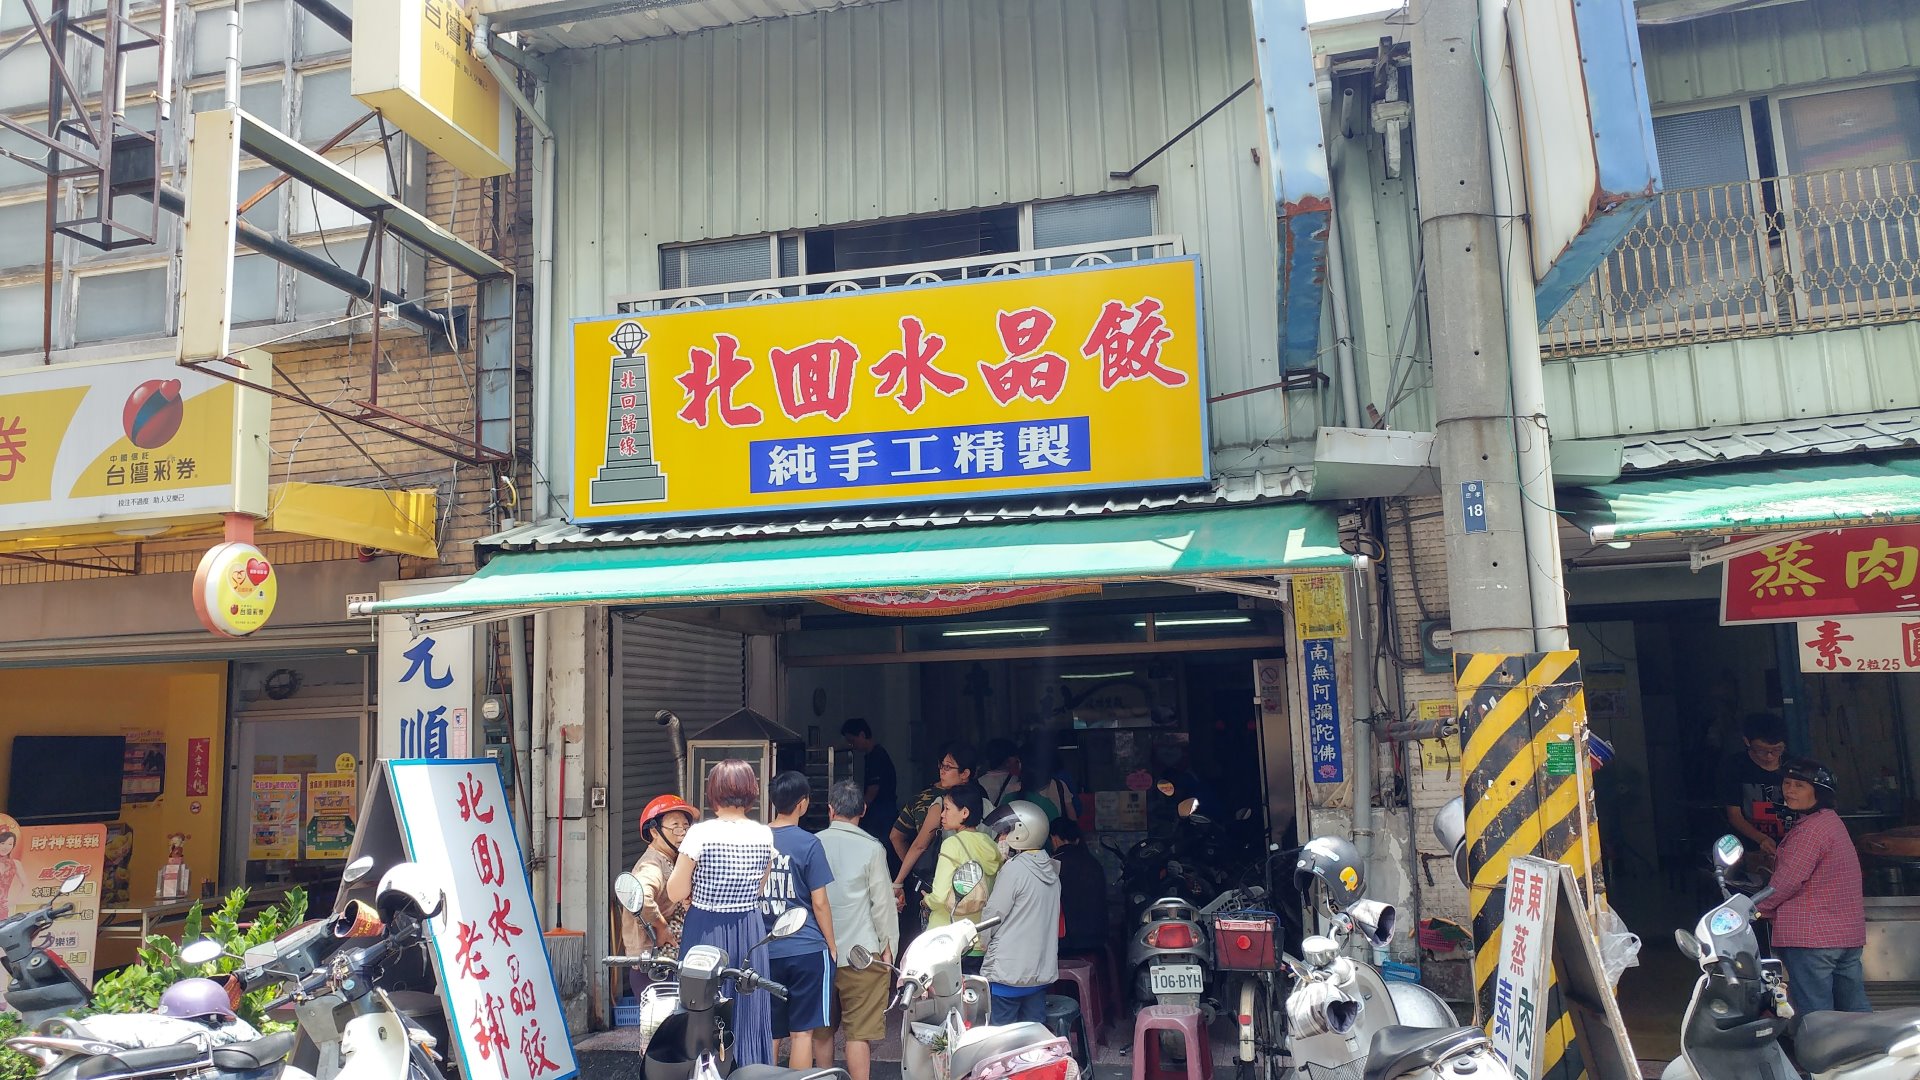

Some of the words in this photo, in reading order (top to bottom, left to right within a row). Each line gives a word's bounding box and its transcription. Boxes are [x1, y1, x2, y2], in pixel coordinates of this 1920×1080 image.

[620, 371, 638, 456] 北回歸線
[106, 457, 196, 486] 台灣彩券
[110, 452, 149, 463] 中國信託
[768, 423, 1072, 487] 純手工精製
[1467, 504, 1483, 517] 18
[1310, 643, 1336, 763] 南無阿彌陀佛
[30, 834, 100, 851] 財神報報
[1509, 867, 1544, 922] 屏東
[1510, 924, 1530, 976] 蒸
[1494, 977, 1514, 1066] 素
